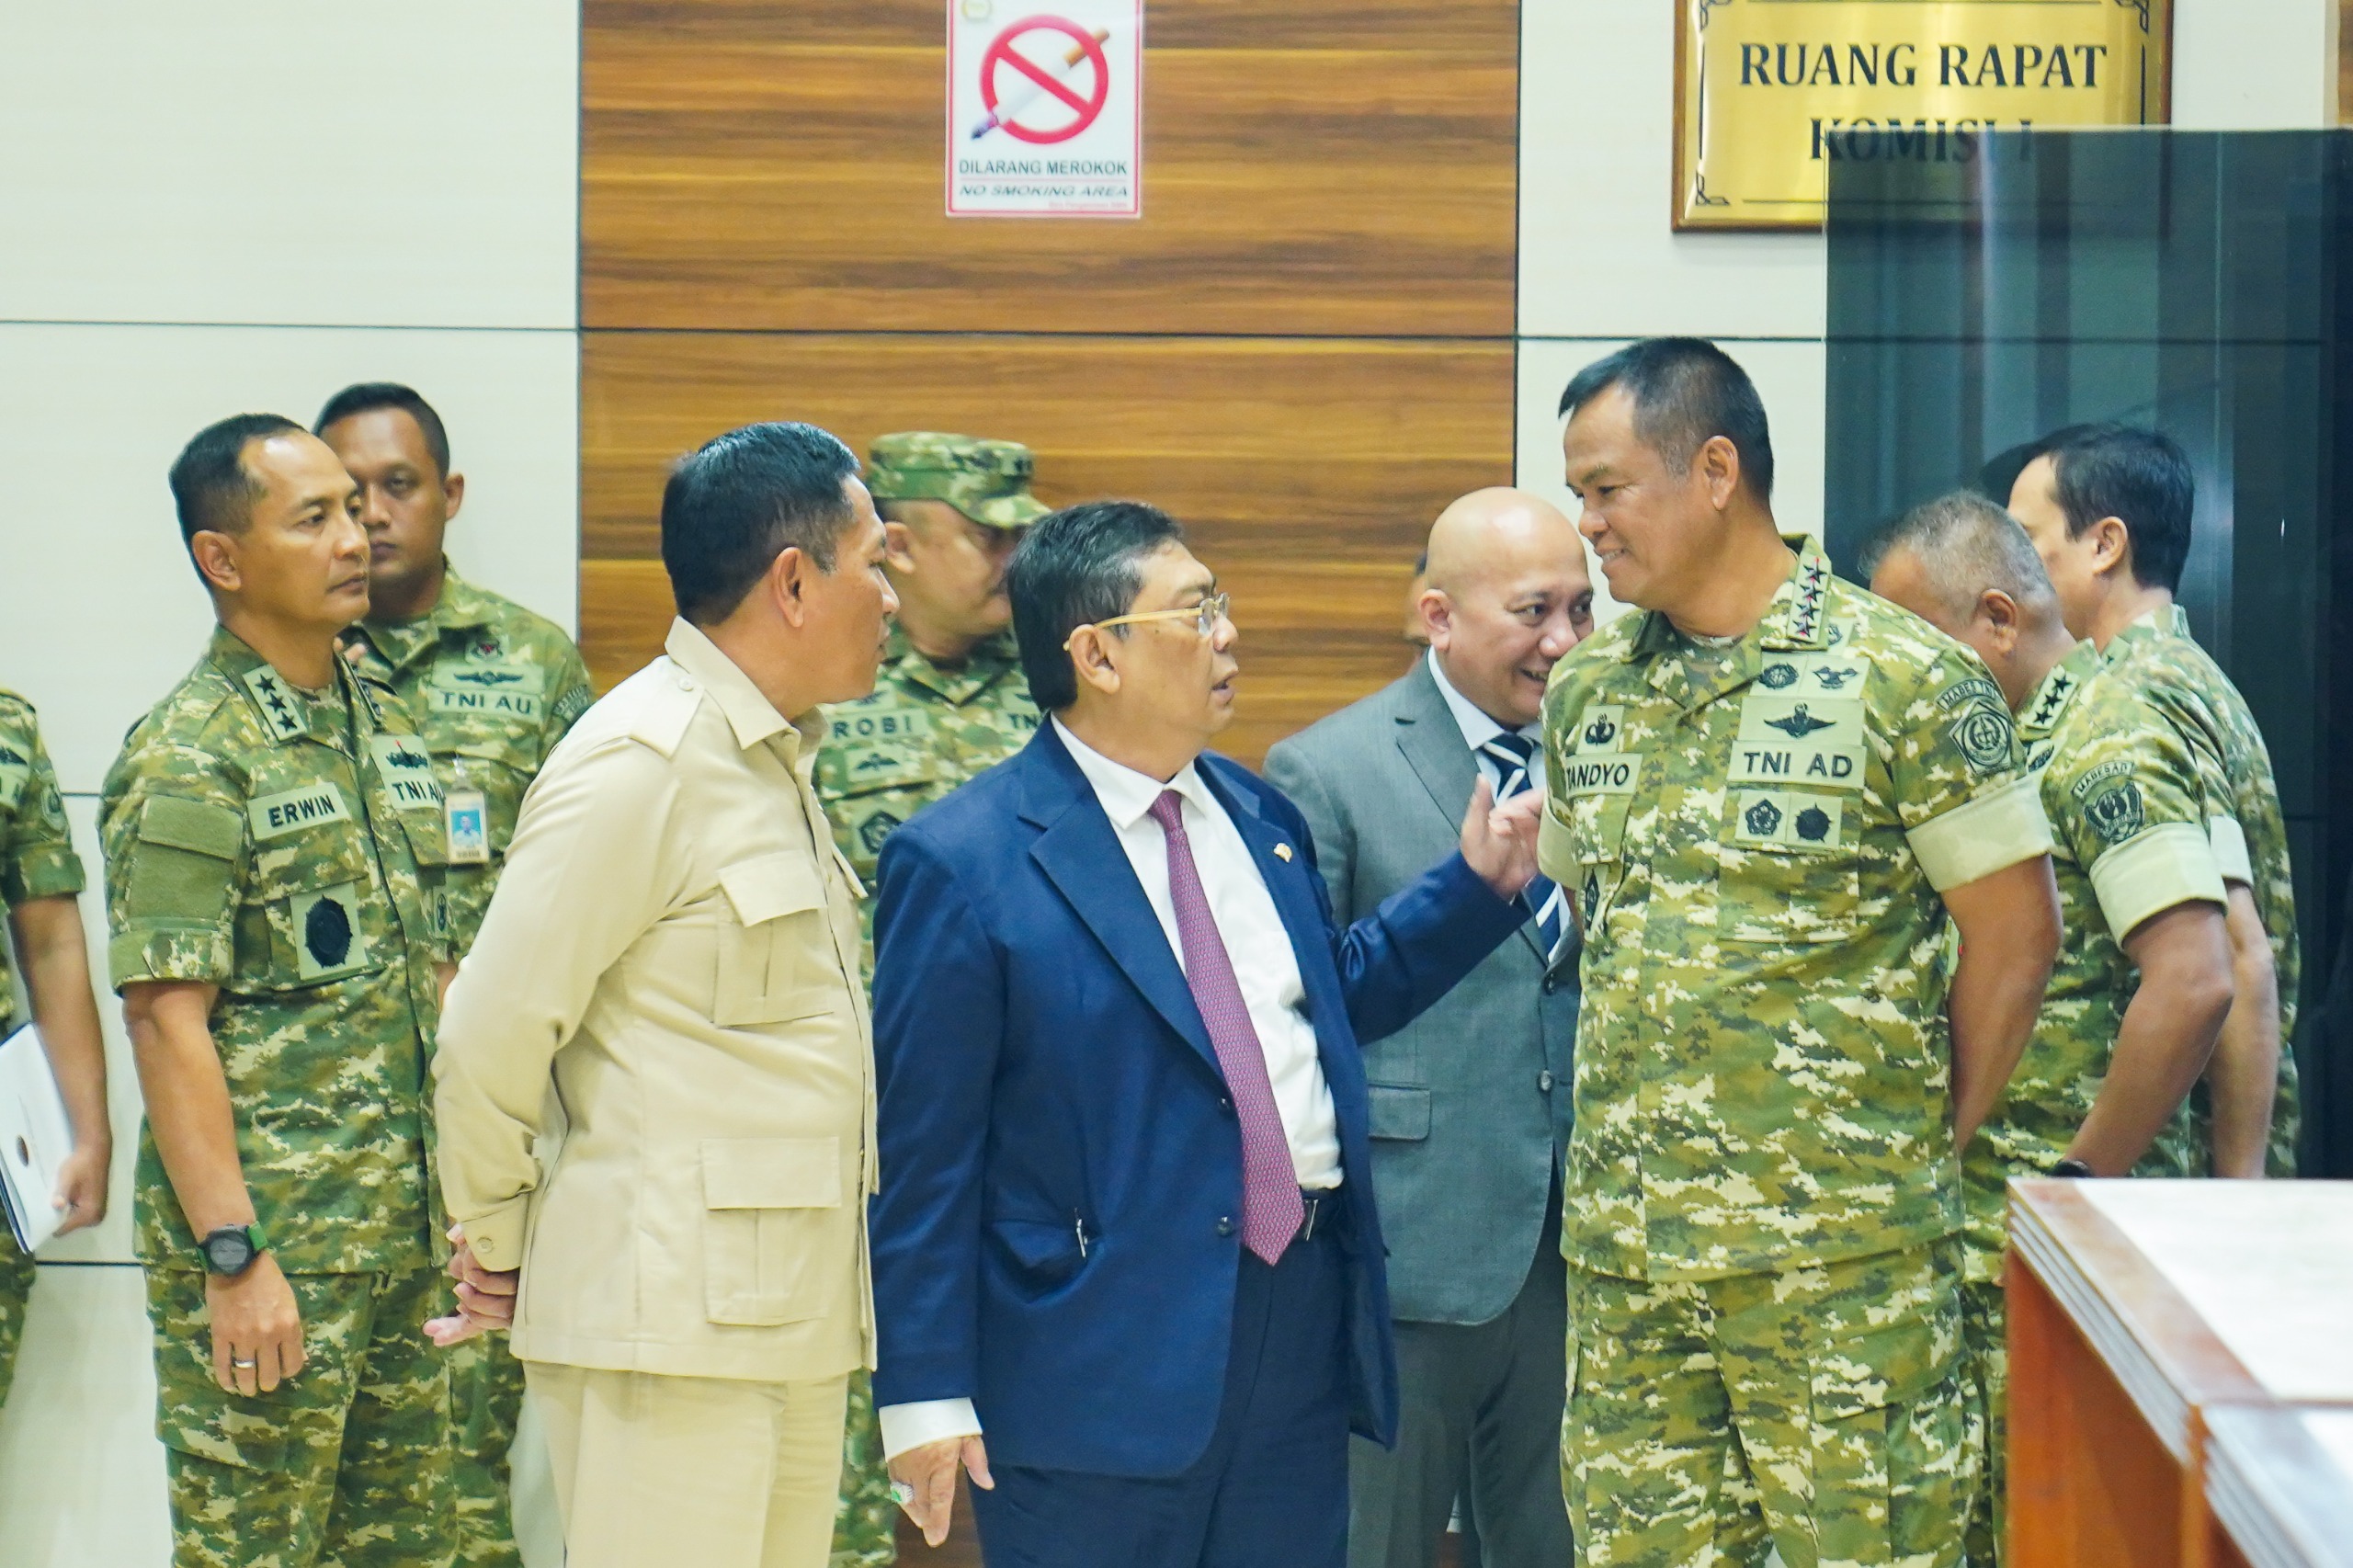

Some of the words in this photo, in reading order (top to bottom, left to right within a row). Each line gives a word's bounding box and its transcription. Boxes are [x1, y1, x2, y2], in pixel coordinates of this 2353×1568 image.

[1740, 42, 1916, 86] RUANG
[1939, 43, 2107, 88] RAPAT
[1810, 118, 1996, 161] KOMISI
[959, 160, 1041, 175] DILARANG
[1046, 160, 1127, 175] MEROKOK
[961, 186, 986, 196] NO
[991, 186, 1074, 196] SMOKING
[1080, 187, 1127, 197] AREA
[442, 692, 484, 707] TNI
[495, 695, 531, 714] AU
[833, 715, 911, 738] ROBI
[1007, 713, 1040, 729] TN
[1744, 752, 1791, 774] TNI
[1806, 753, 1853, 778] AD
[392, 780, 426, 801] TNI
[268, 794, 335, 827] ERWIN
